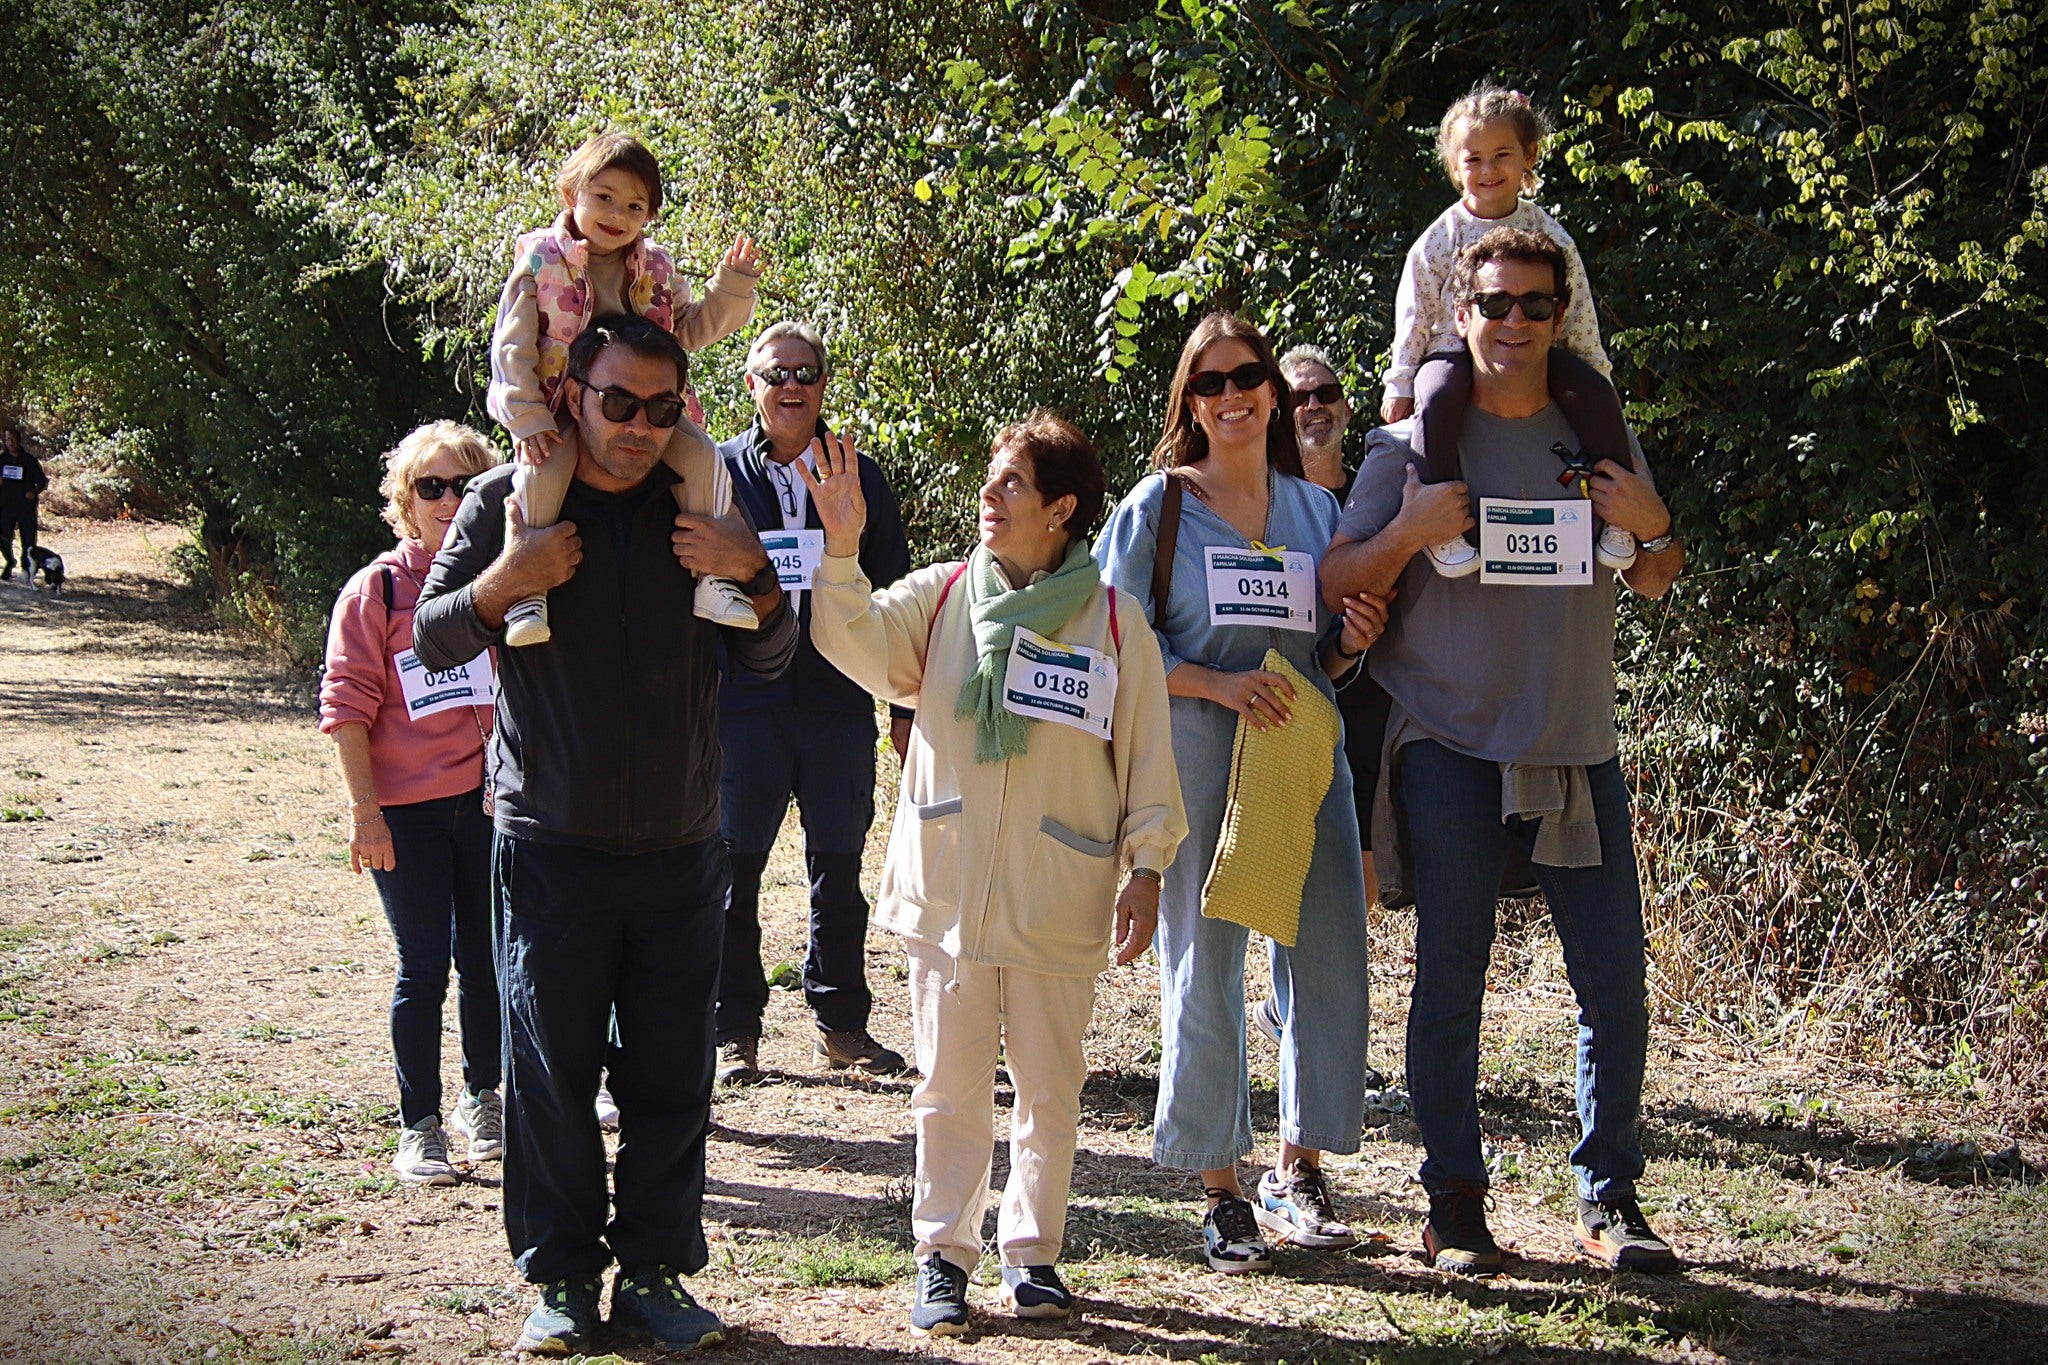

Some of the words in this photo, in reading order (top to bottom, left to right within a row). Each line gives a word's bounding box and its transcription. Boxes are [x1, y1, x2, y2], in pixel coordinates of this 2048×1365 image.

[1506, 534, 1558, 554] 0316
[772, 555, 802, 569] 045
[1238, 578, 1289, 599] 0314
[1018, 646, 1037, 659] FAMILIAR
[1024, 640, 1040, 653] MARCHA
[1042, 650, 1070, 658] SOLIDARIA
[424, 666, 470, 687] 0264
[1034, 672, 1088, 699] 0188
[1043, 701, 1064, 709] OCTUBRE
